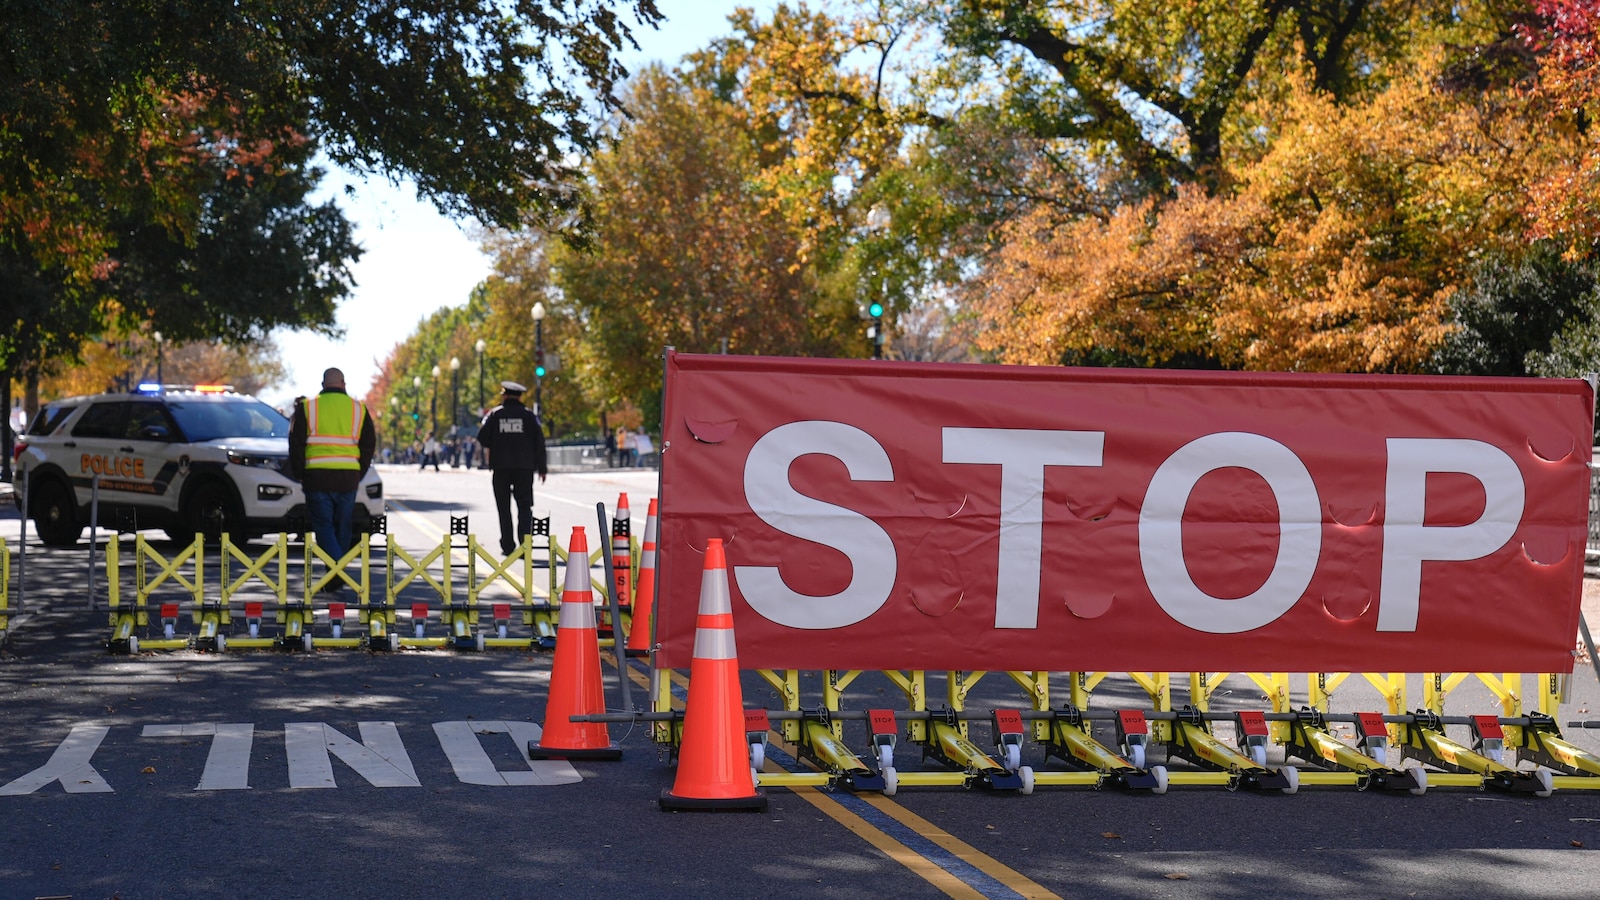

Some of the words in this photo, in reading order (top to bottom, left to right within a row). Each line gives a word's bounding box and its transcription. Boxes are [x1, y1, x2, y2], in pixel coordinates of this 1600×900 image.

[499, 423, 524, 433] POLICE
[81, 454, 145, 478] POLICE
[733, 419, 1527, 634] STOP
[0, 720, 583, 796] ONLY
